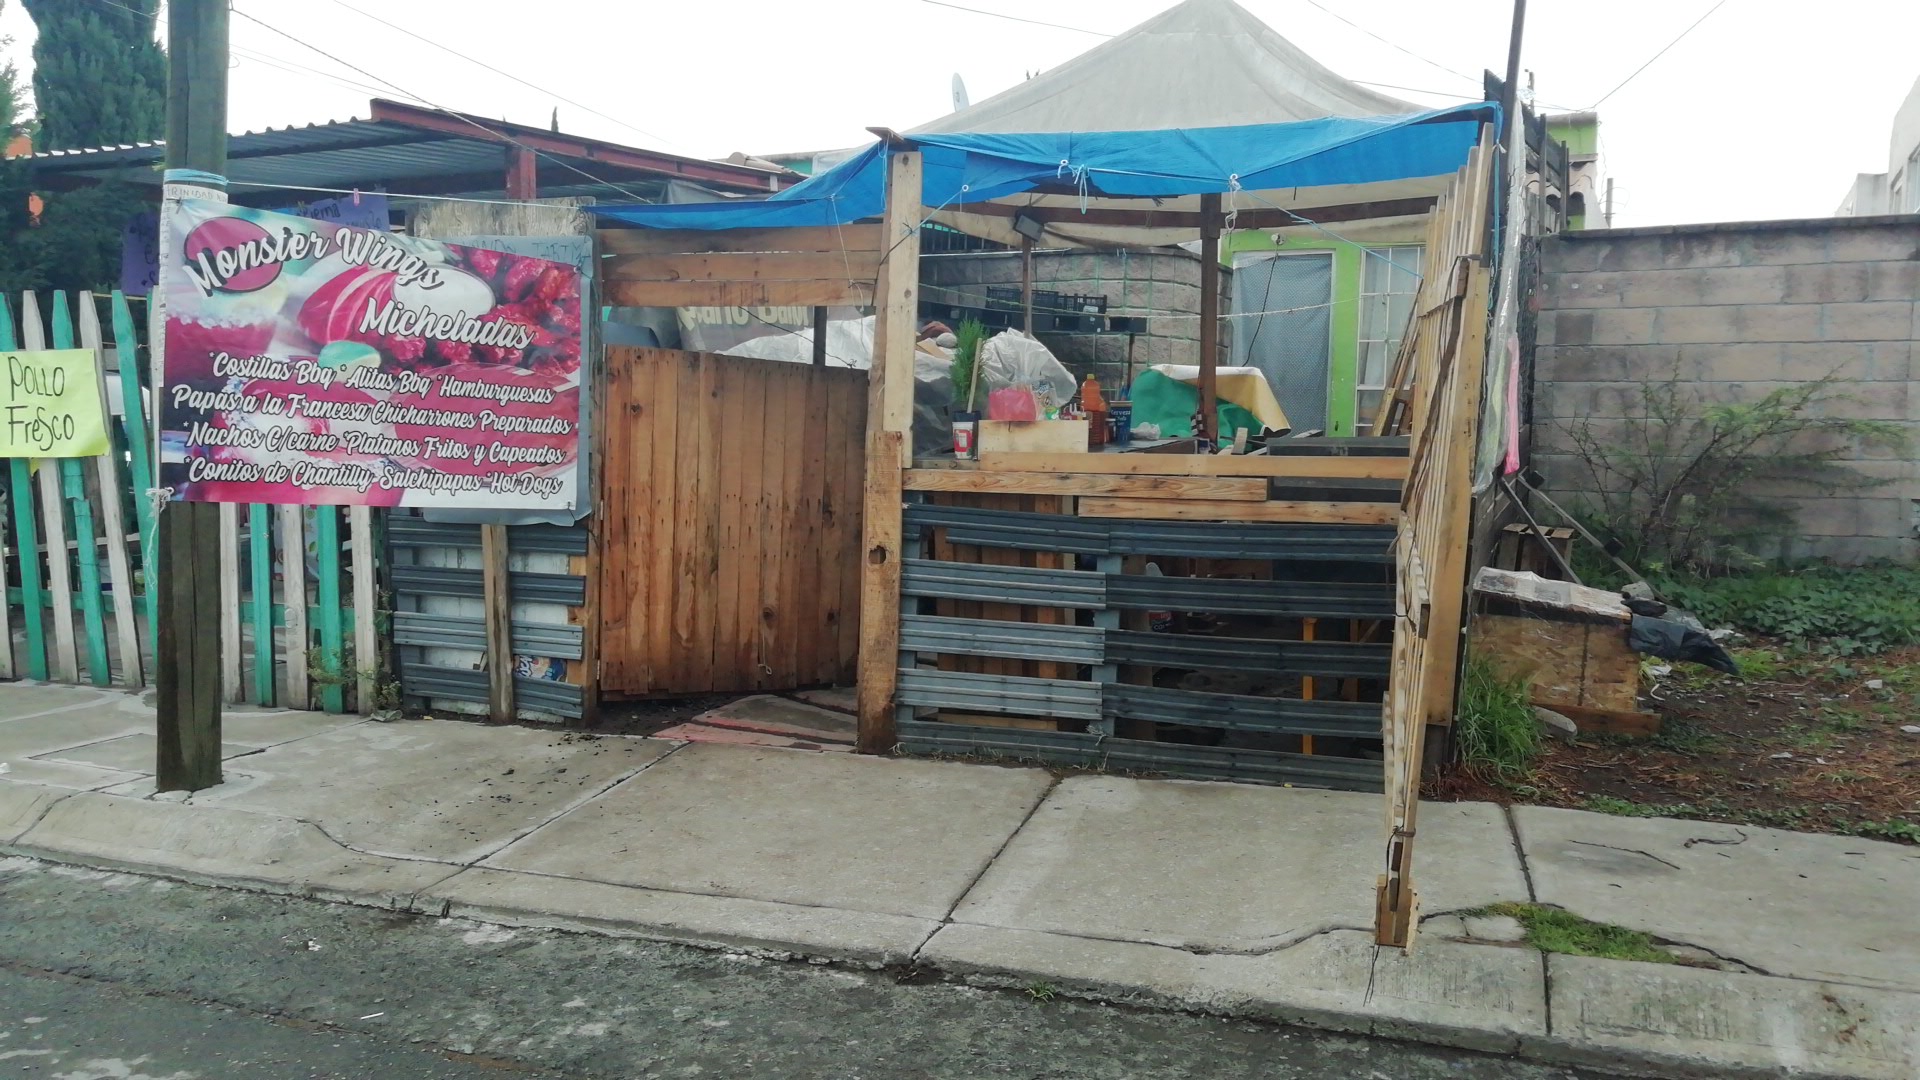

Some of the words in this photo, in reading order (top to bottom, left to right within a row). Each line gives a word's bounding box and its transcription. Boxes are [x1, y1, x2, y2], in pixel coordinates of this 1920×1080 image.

[182, 227, 330, 297] Monster
[335, 228, 444, 290] Wings
[359, 297, 535, 349] Micheladas
[8, 356, 65, 401] POLLO
[213, 351, 295, 382] Costillas
[296, 360, 336, 390] Bbq
[345, 366, 396, 391] Alitas
[398, 370, 433, 399] Bbq
[439, 375, 555, 406] Hamburguesas
[172, 384, 240, 415] Papas
[241, 395, 260, 413] a
[260, 392, 285, 415] la
[286, 393, 370, 422] Francesa
[371, 400, 478, 429] Chicharrones
[479, 410, 573, 436] Preparados
[186, 421, 265, 448] Nachos
[265, 425, 339, 452] C/carne
[346, 432, 422, 457] Platanos
[422, 436, 471, 460] Fritos
[472, 448, 487, 466] y
[488, 441, 566, 466] Capeados
[189, 457, 264, 483] Conitos
[264, 461, 290, 484] de
[291, 462, 373, 493] Chantilly
[379, 465, 483, 496] Salchipapas
[490, 472, 518, 494] Hot
[518, 473, 563, 499] Dogs
